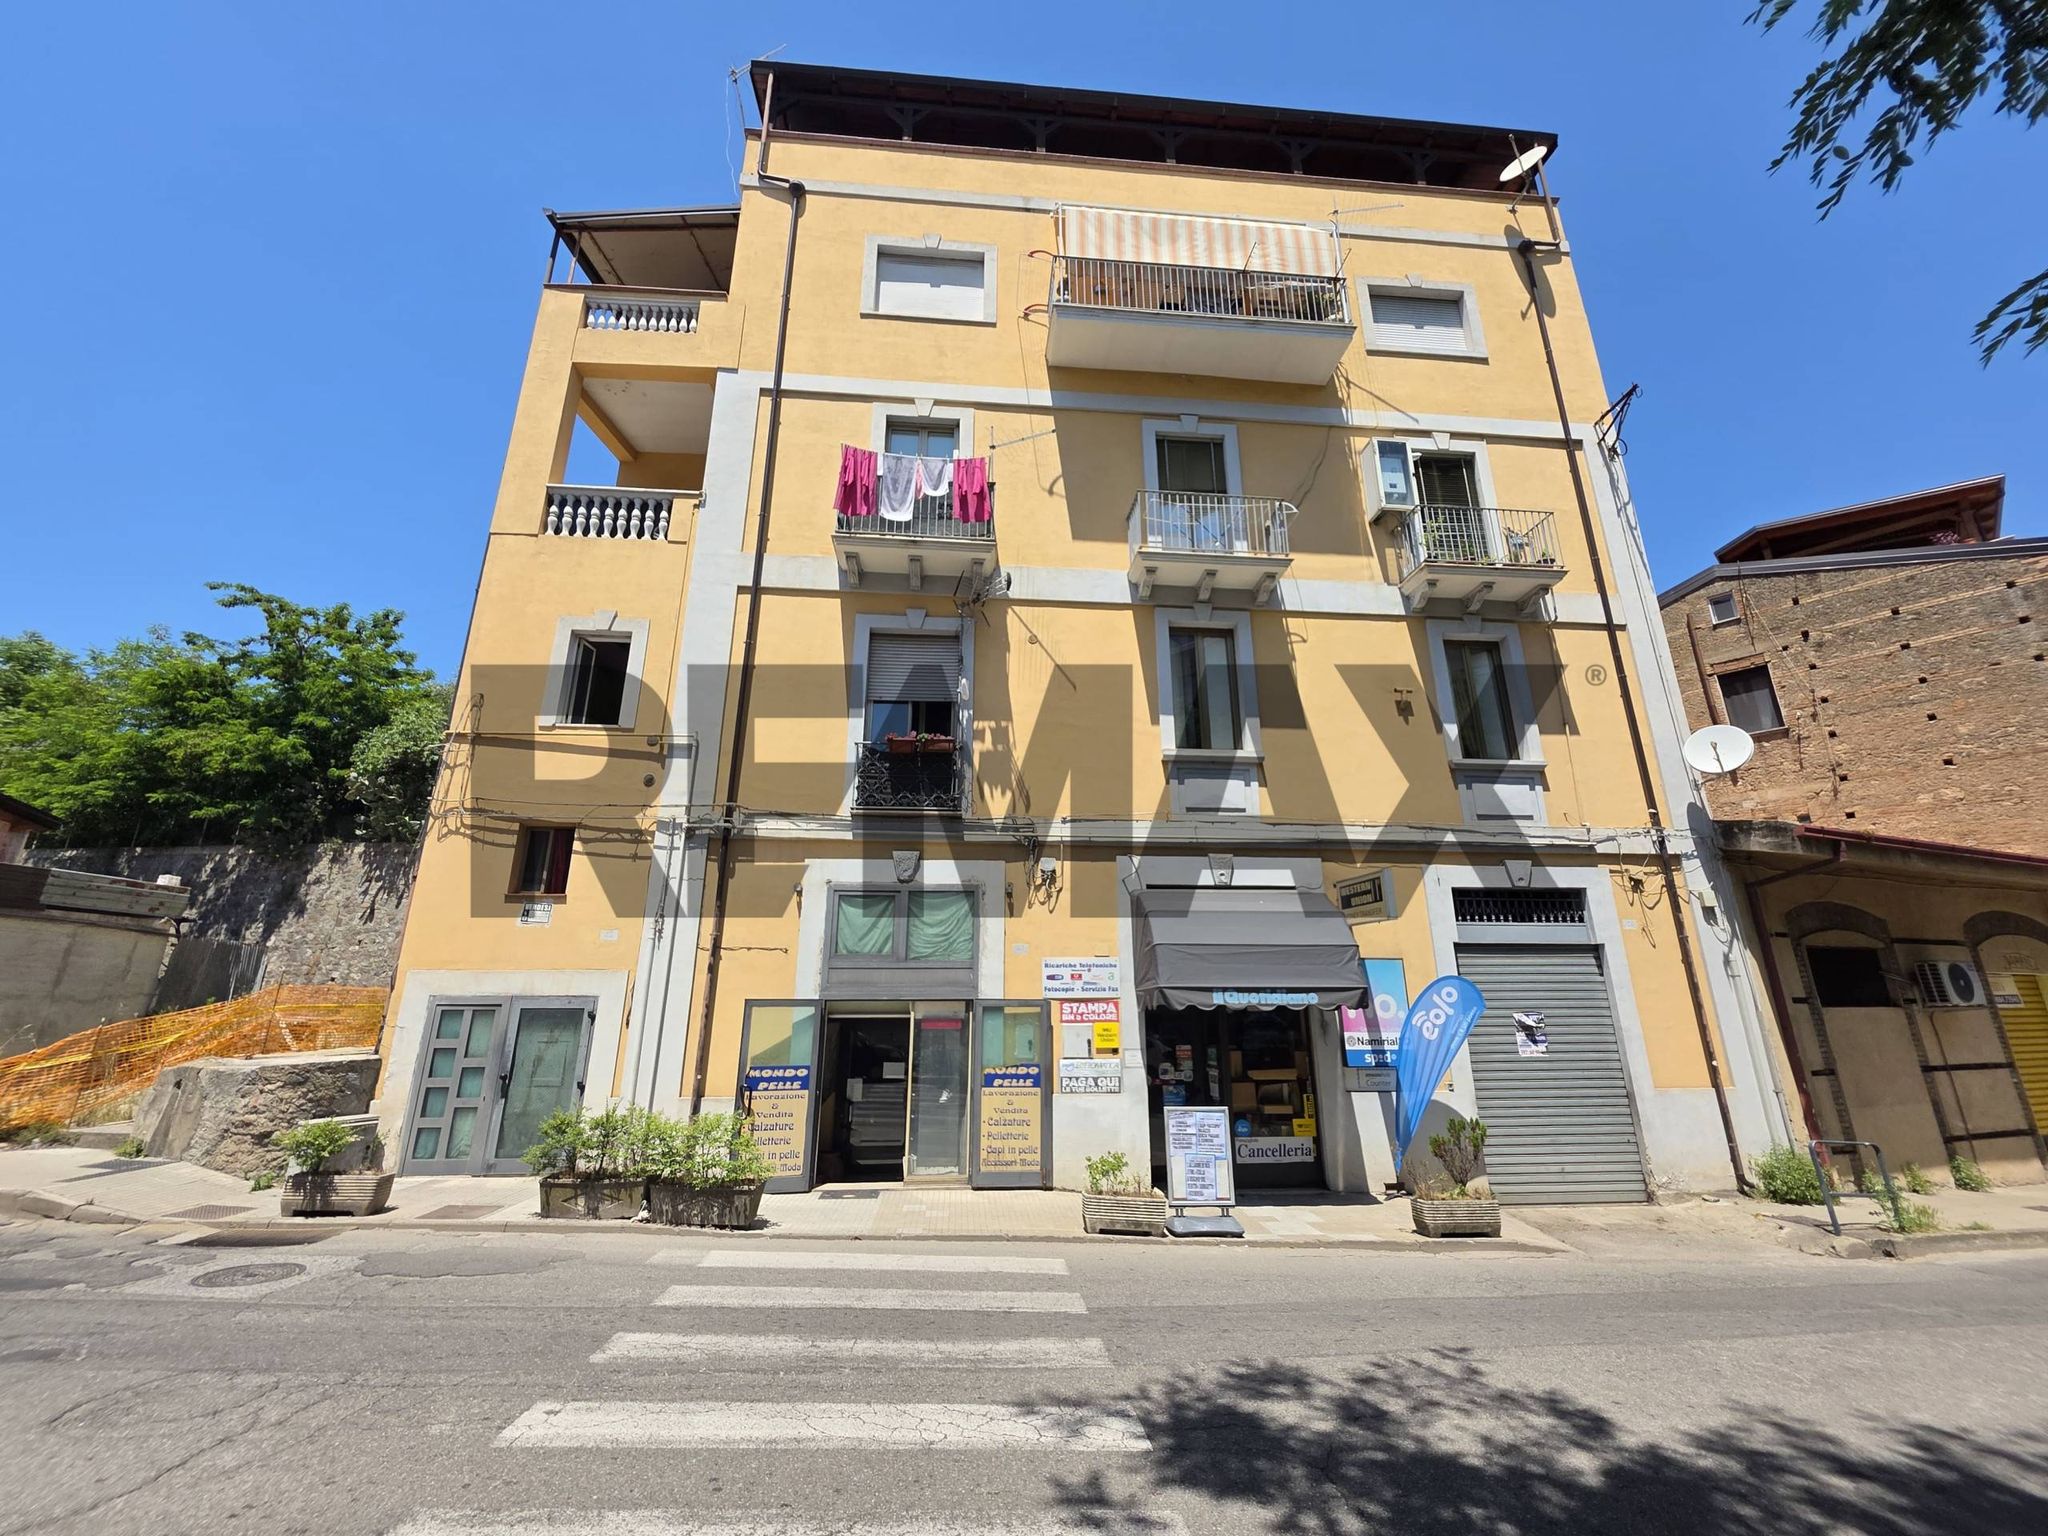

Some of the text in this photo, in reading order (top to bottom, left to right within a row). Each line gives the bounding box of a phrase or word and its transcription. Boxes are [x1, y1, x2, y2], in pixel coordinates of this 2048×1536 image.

[1340, 881, 1371, 896] WESTERN
[1351, 894, 1372, 906] UNION
[1062, 1002, 1117, 1013] STAMPA
[1357, 1037, 1398, 1046] Namirial
[749, 1068, 808, 1078] MONDO
[983, 1066, 1039, 1075] MONDO
[757, 1081, 802, 1090] PELLE
[993, 1078, 1034, 1087] PELLE
[1062, 1077, 1119, 1087] PAGA QUI
[987, 1117, 1031, 1126] Calzature
[987, 1131, 1029, 1140] Pelletterie
[768, 1151, 776, 1159] in
[779, 1149, 800, 1161] pelle
[986, 1145, 1038, 1156] Capi in pelle
[1237, 1143, 1312, 1158] Cancelleria
